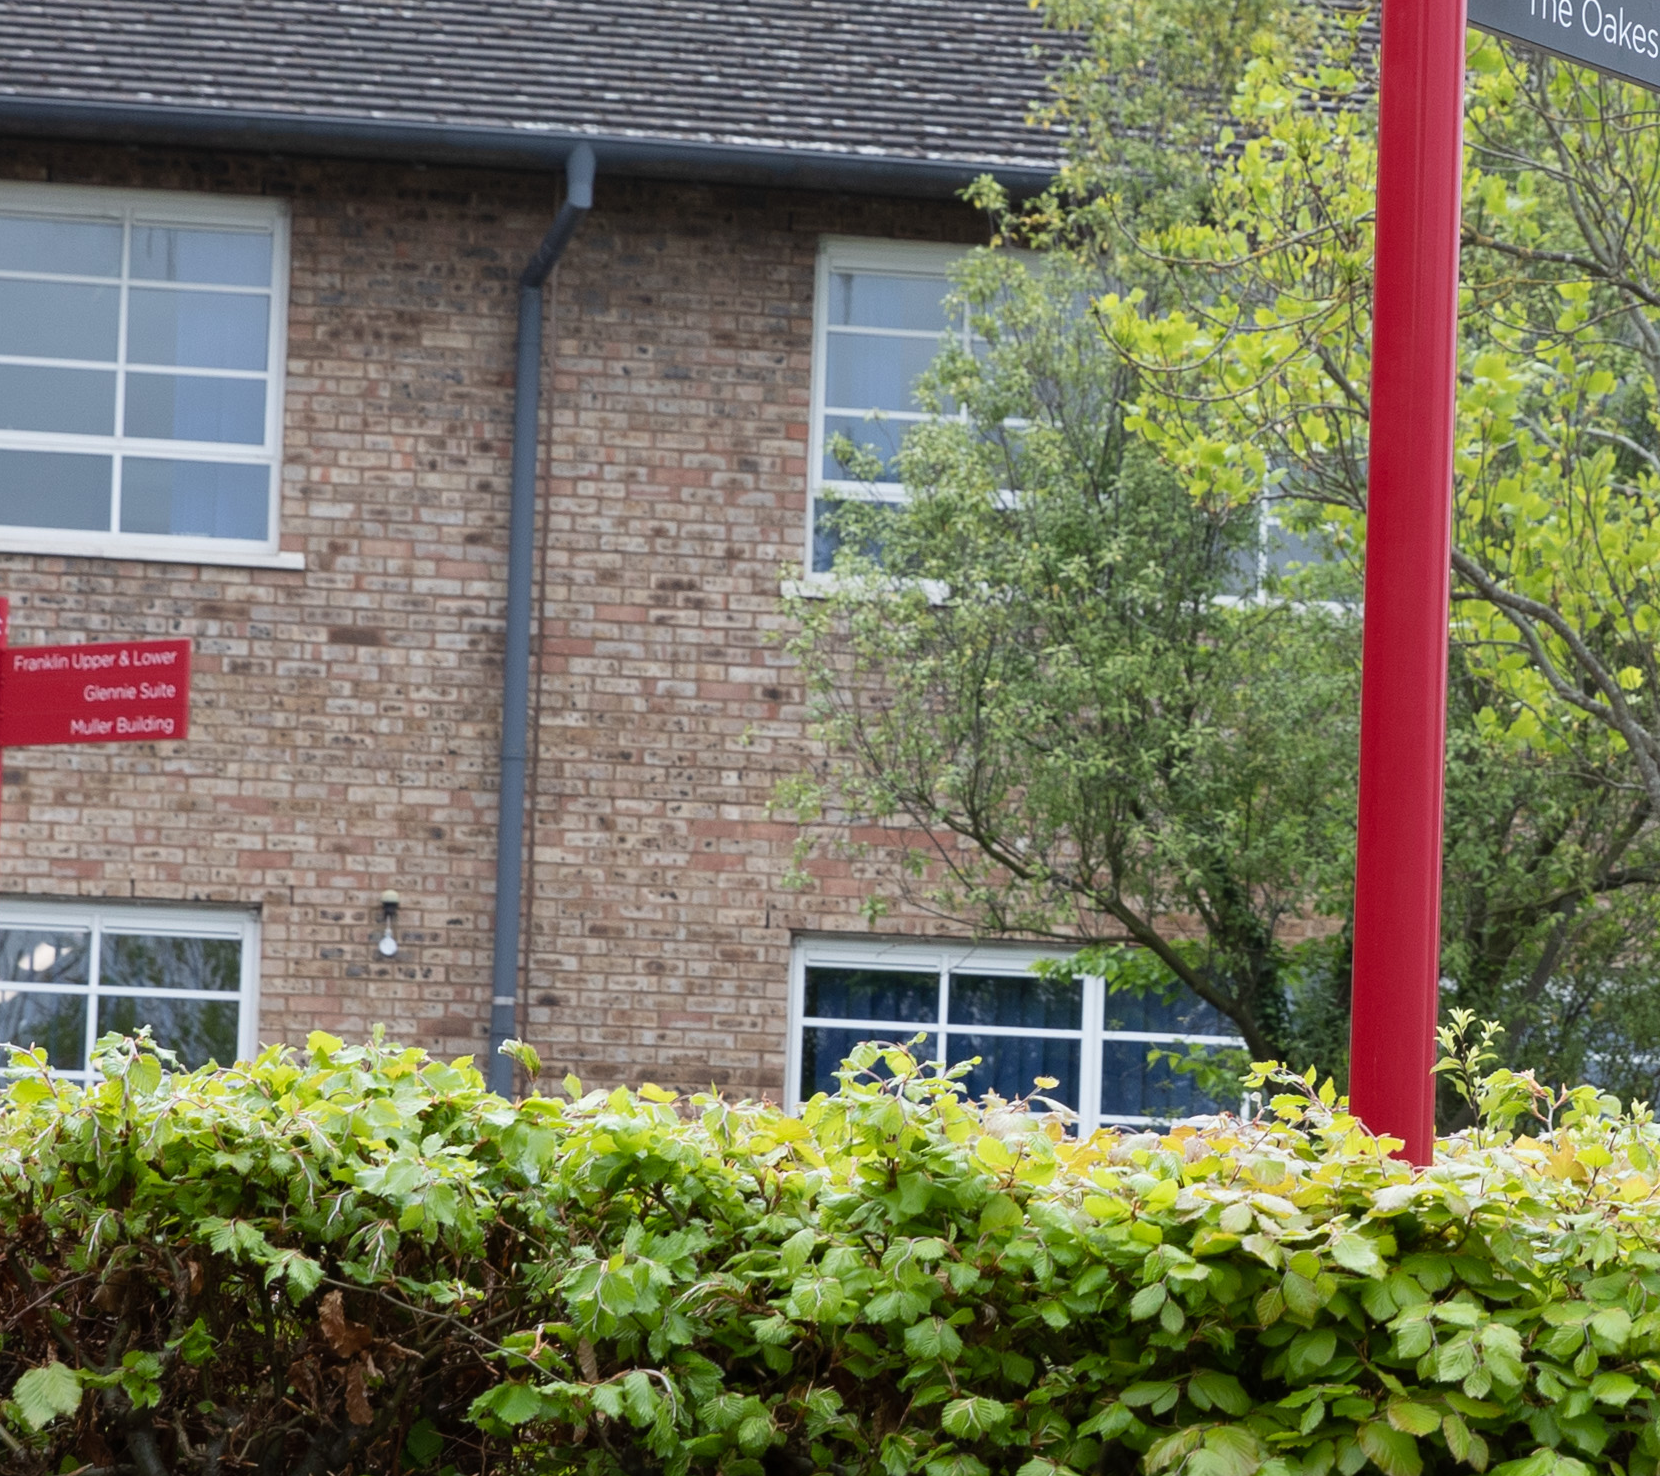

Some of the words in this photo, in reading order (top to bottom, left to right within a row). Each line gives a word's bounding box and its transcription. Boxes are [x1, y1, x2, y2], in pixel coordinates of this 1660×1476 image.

[13, 652, 69, 672] Franklin
[71, 652, 116, 670] Upper
[118, 649, 130, 667] &
[132, 649, 178, 667] Lower
[83, 683, 137, 703] Glennie
[139, 681, 177, 700] Suite
[69, 717, 114, 736] Muller
[116, 715, 175, 736] Building
